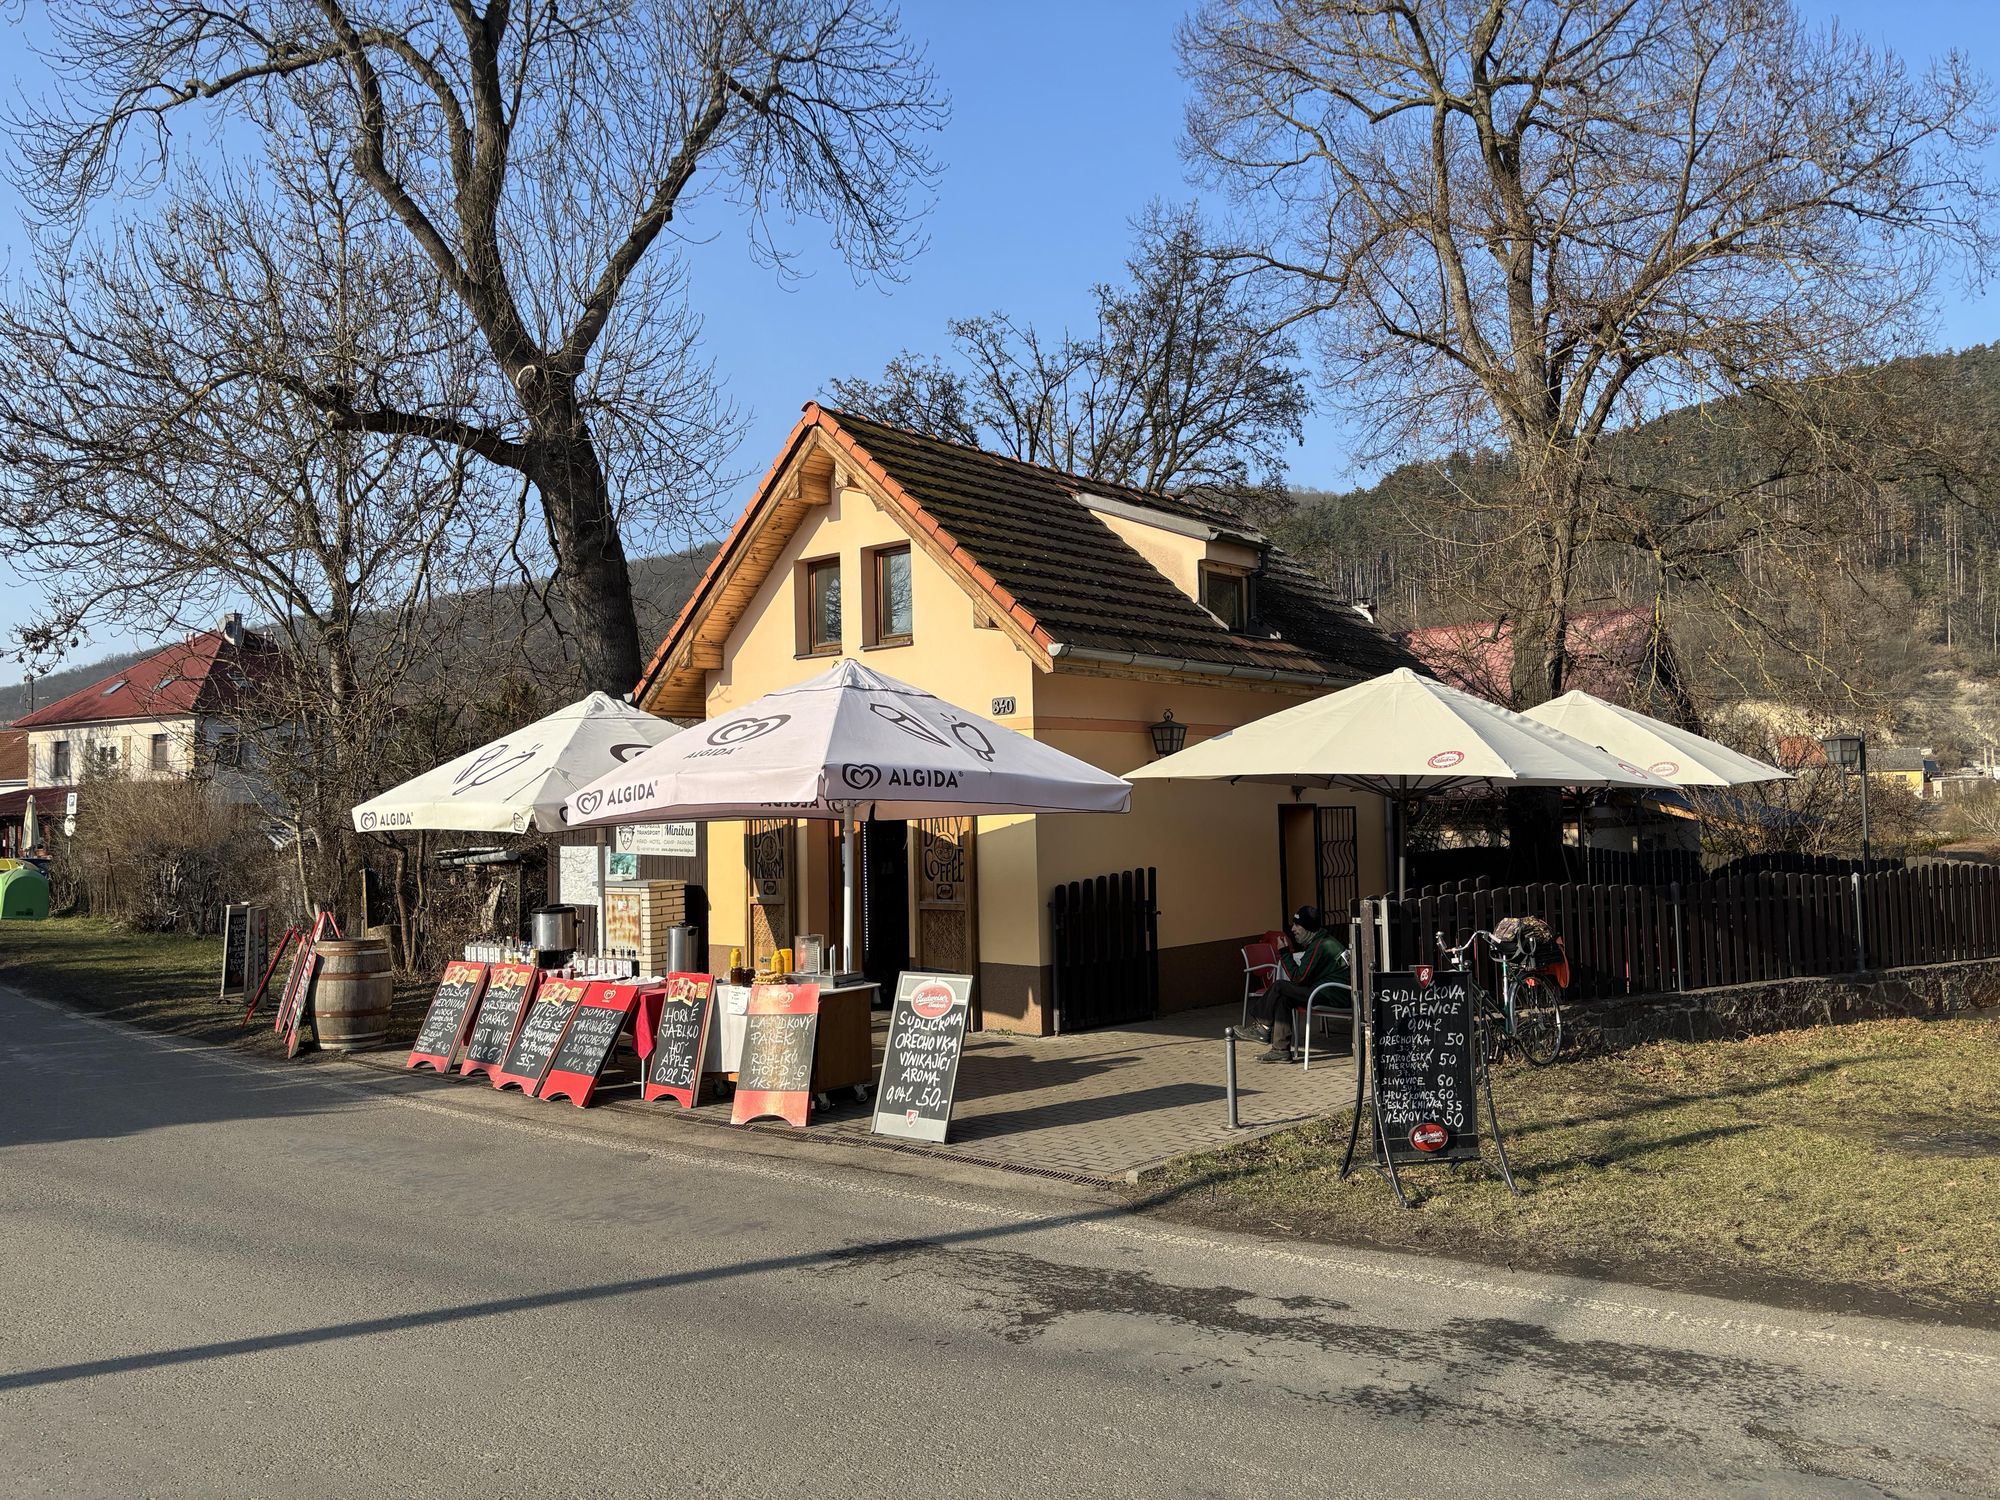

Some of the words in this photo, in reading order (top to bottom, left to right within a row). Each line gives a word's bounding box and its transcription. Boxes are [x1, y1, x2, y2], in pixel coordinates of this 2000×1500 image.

[992, 698, 1014, 715] 340
[683, 747, 737, 760] ALGIDA
[888, 768, 959, 789] ALGIDA
[607, 782, 655, 806] ALGIDA
[380, 812, 412, 826] ALGIDA
[664, 824, 694, 836] Minibus
[925, 849, 964, 882] COFFEE
[1379, 980, 1466, 1003] SUDLIČKOVA
[664, 1002, 700, 1023] HORKÉ
[898, 1010, 963, 1032] SUDLIČKOVA
[551, 1020, 567, 1031] SE
[661, 1023, 699, 1039] JABLKO
[474, 1028, 491, 1044] HOT
[574, 1033, 611, 1047] VYROBENO
[895, 1026, 958, 1053] OŘECHOVKA
[1379, 1027, 1432, 1046] OŘECHOVKA
[1444, 1032, 1465, 1046] 50
[668, 1039, 690, 1055] HOT
[661, 1051, 693, 1068] APPLE
[1380, 1047, 1435, 1064] STAROČESKÁ
[1438, 1052, 1457, 1066] 50
[585, 1058, 601, 1073] 45
[778, 1064, 808, 1081] DG
[900, 1067, 941, 1087] AROMA
[1381, 1076, 1426, 1087] SLIVOVICE
[1437, 1074, 1454, 1087] 60
[915, 1087, 948, 1112] 50,-
[1382, 1090, 1436, 1101] HRUŠKOVICE
[1438, 1088, 1454, 1100] 60
[1447, 1100, 1463, 1111] 55
[1442, 1110, 1464, 1128] 50
